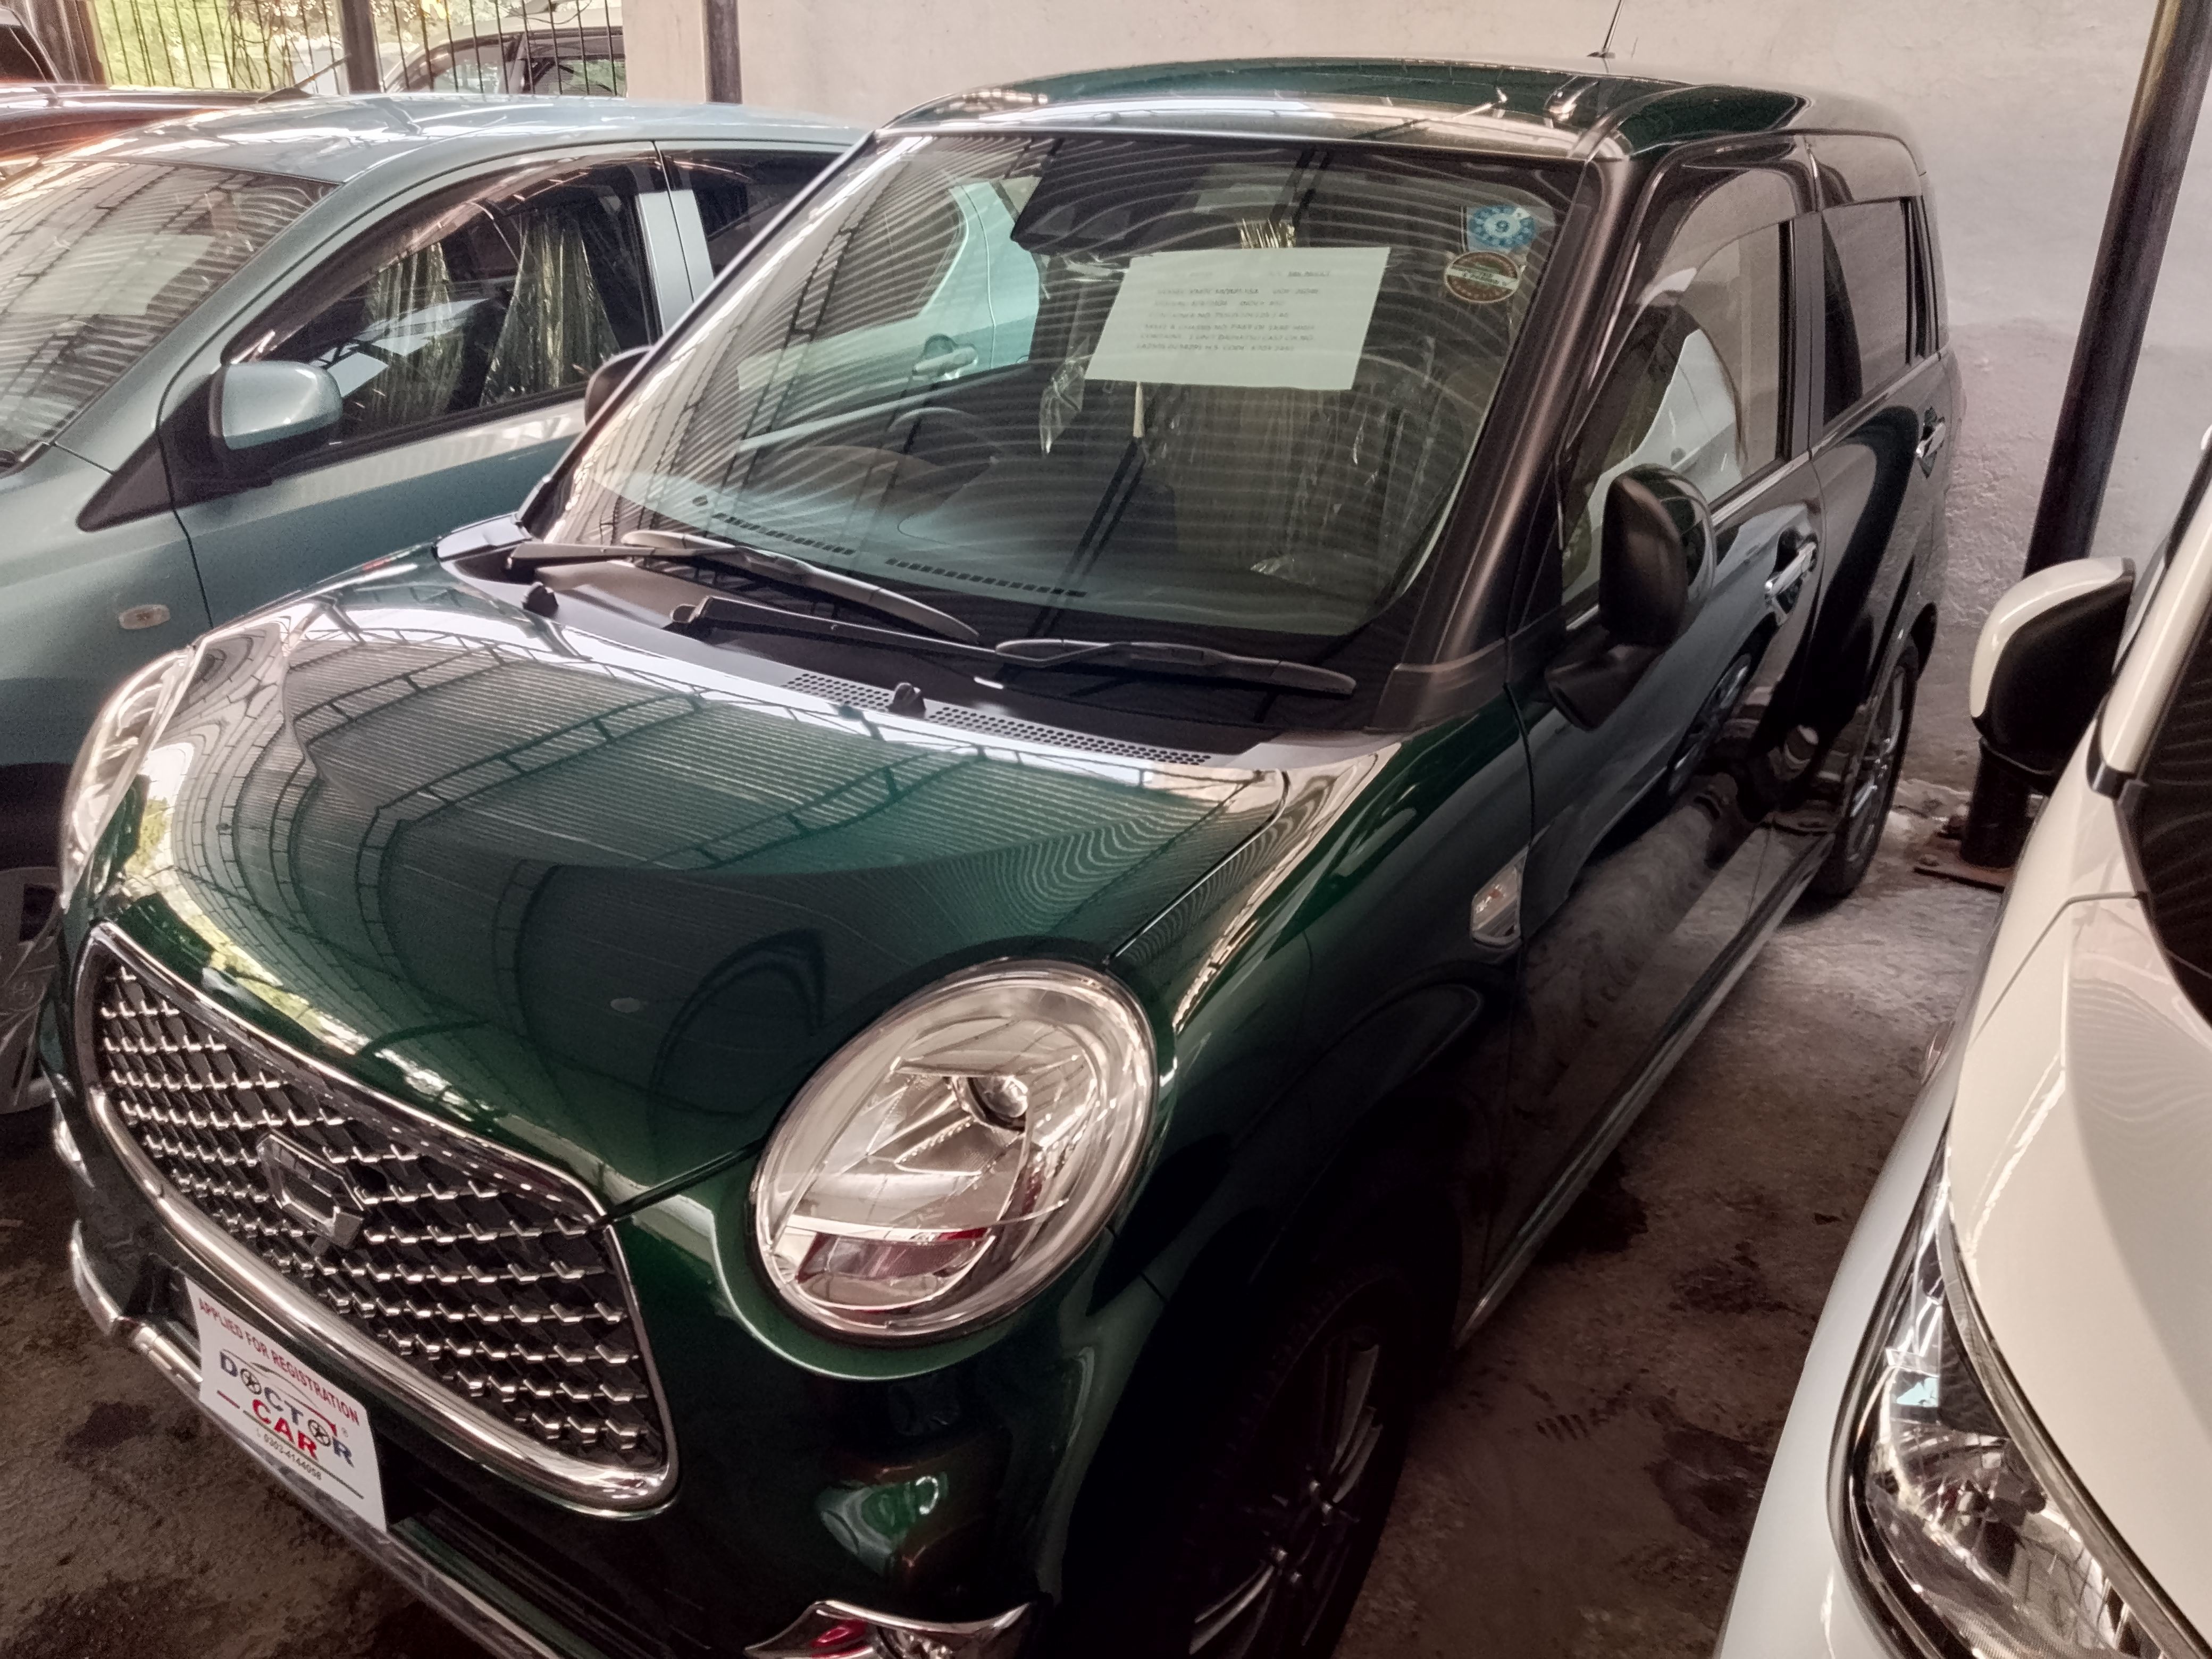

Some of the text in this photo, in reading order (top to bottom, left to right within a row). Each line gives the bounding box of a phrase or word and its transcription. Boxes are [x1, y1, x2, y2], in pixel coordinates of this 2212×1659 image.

[199, 1297, 359, 1426] APPLIED FOR REGISTRATION
[219, 1351, 355, 1468] DOCTOR
[252, 1398, 319, 1461] CAR
